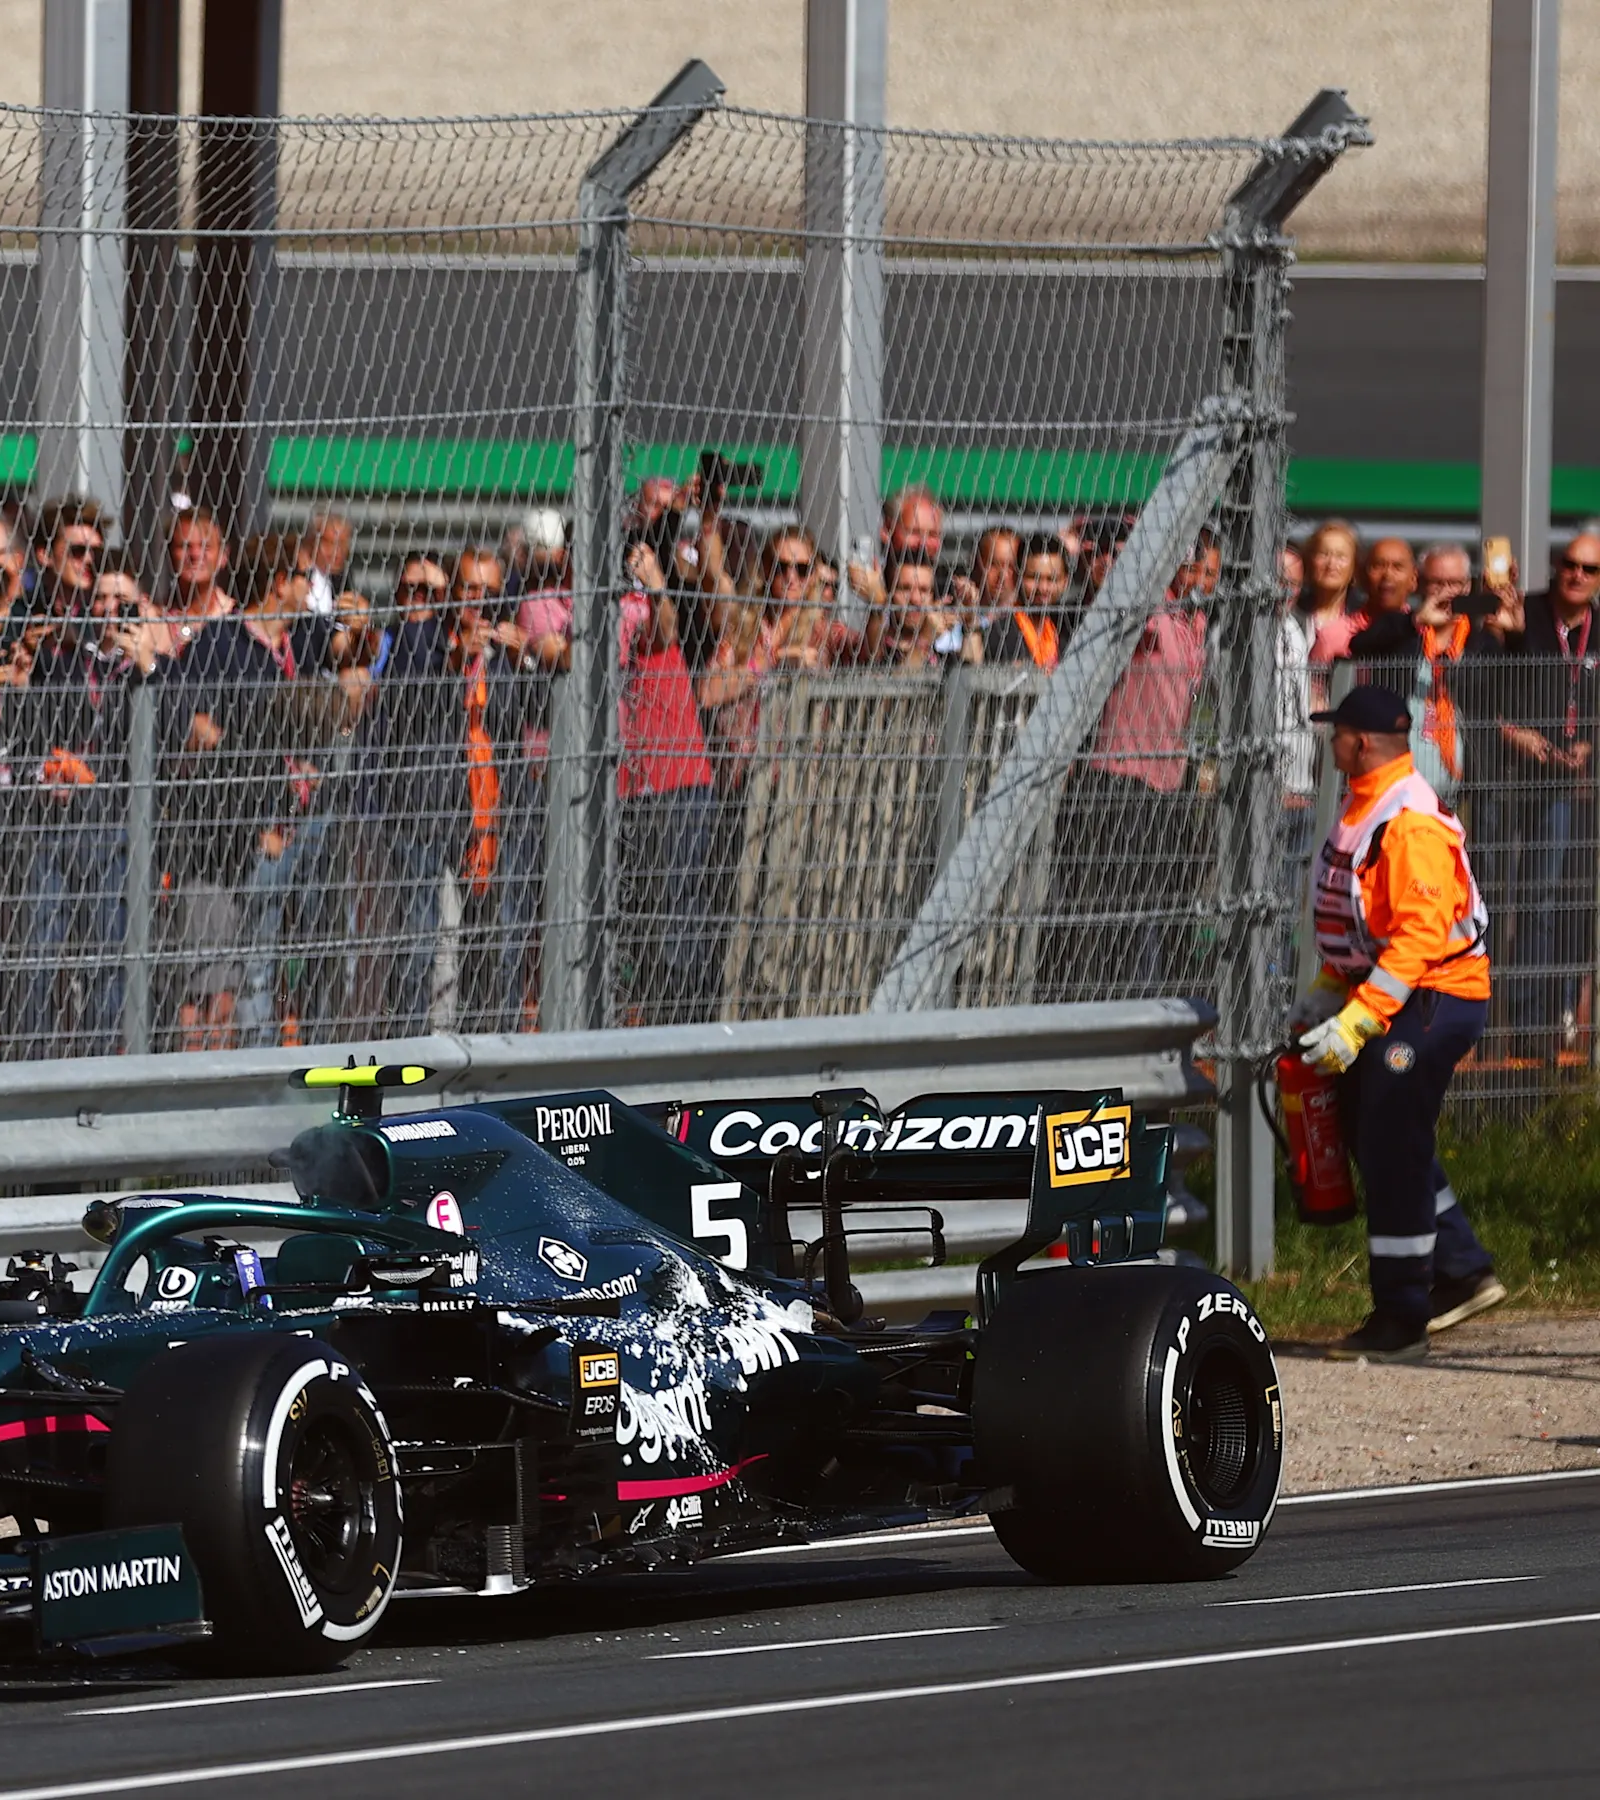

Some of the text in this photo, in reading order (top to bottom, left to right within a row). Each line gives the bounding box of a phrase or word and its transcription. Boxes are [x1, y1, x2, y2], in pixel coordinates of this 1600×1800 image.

[535, 1103, 613, 1143] PERONI
[560, 1143, 590, 1156] LIBERA
[1055, 1121, 1125, 1171] JCB
[690, 1181, 748, 1270] 5
[423, 1300, 475, 1312] OAKLEY
[1177, 1293, 1266, 1354] P ZERO
[330, 1361, 350, 1381] P
[584, 1359, 617, 1382] JCB
[1202, 1519, 1260, 1548] PIRELLI
[43, 1555, 181, 1601] ASTON MARTIN
[265, 1515, 324, 1629] PIRELLI
